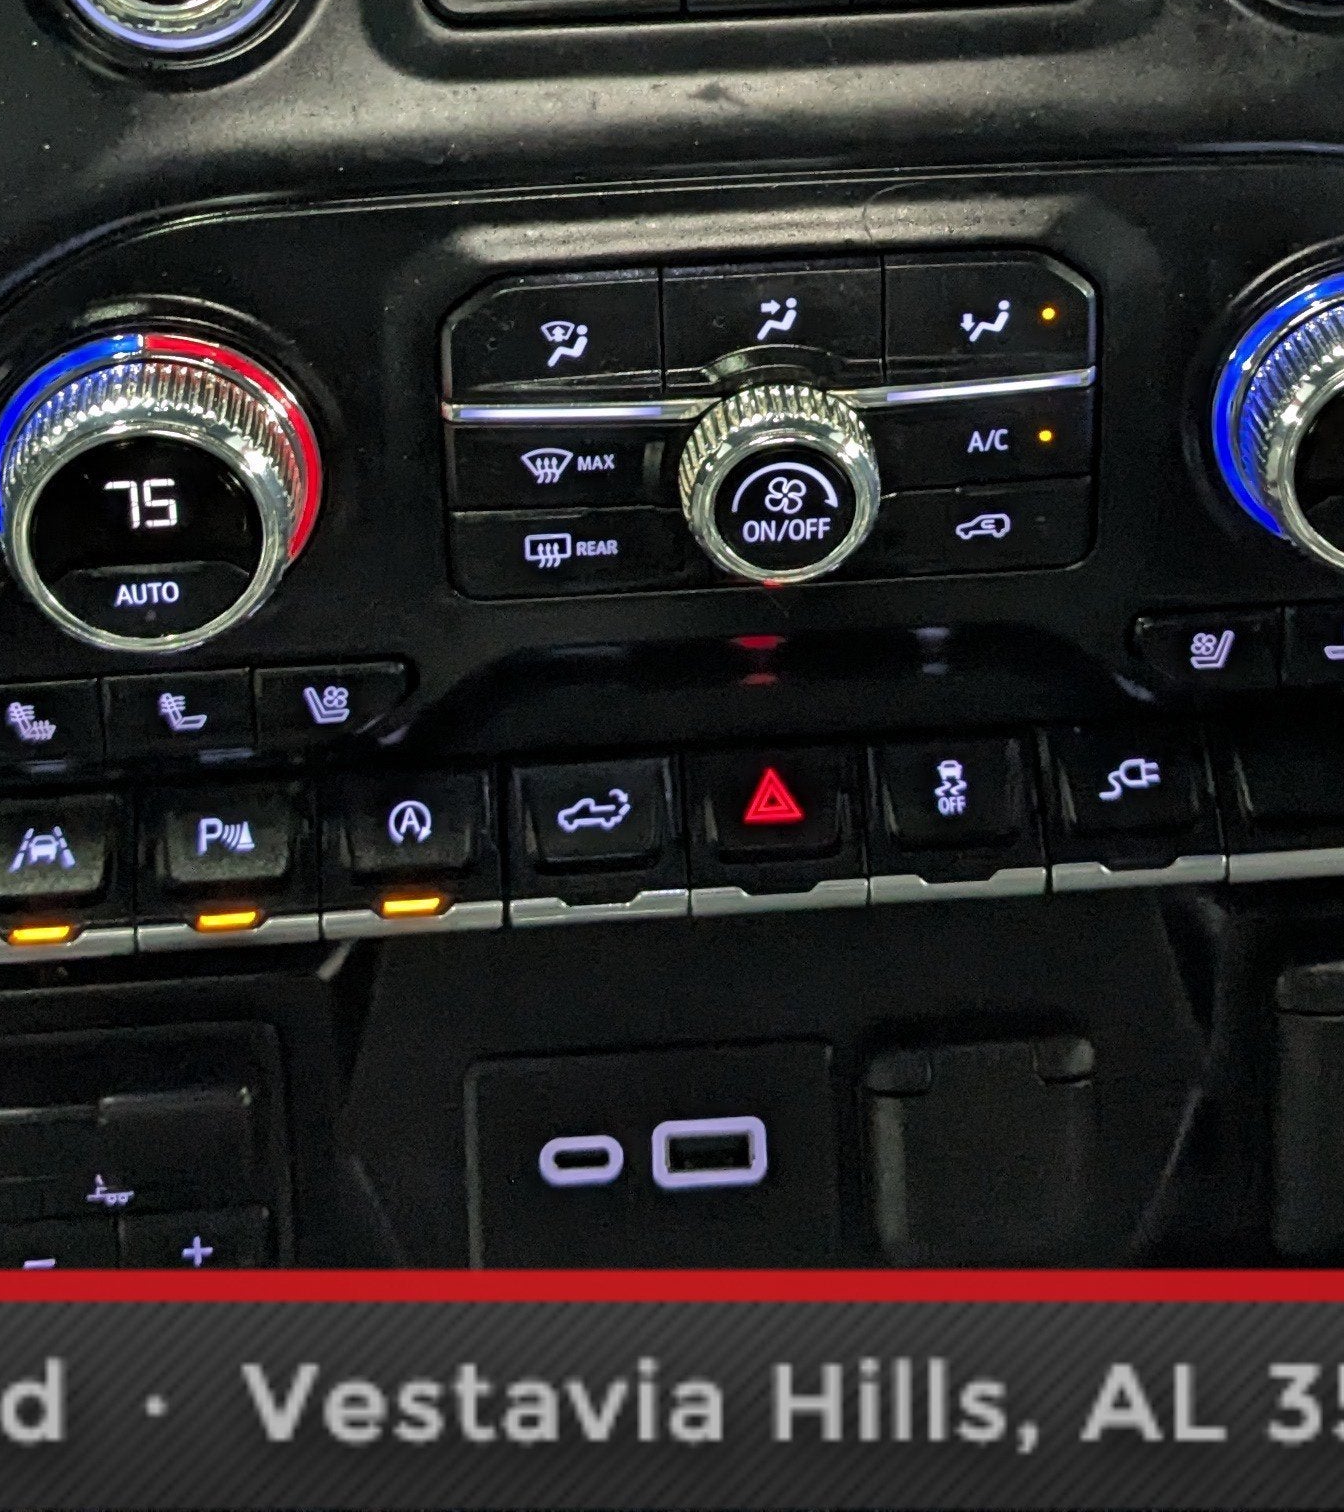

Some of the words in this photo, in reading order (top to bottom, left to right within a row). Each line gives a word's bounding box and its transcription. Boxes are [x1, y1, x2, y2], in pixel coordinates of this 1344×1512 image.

[967, 427, 1009, 453] A/C
[577, 453, 615, 472] MAX
[104, 478, 178, 529] 75
[742, 517, 831, 544] ON/OFF
[575, 539, 619, 557] REAR
[115, 581, 180, 607] AUTO
[937, 795, 967, 816] OFF
